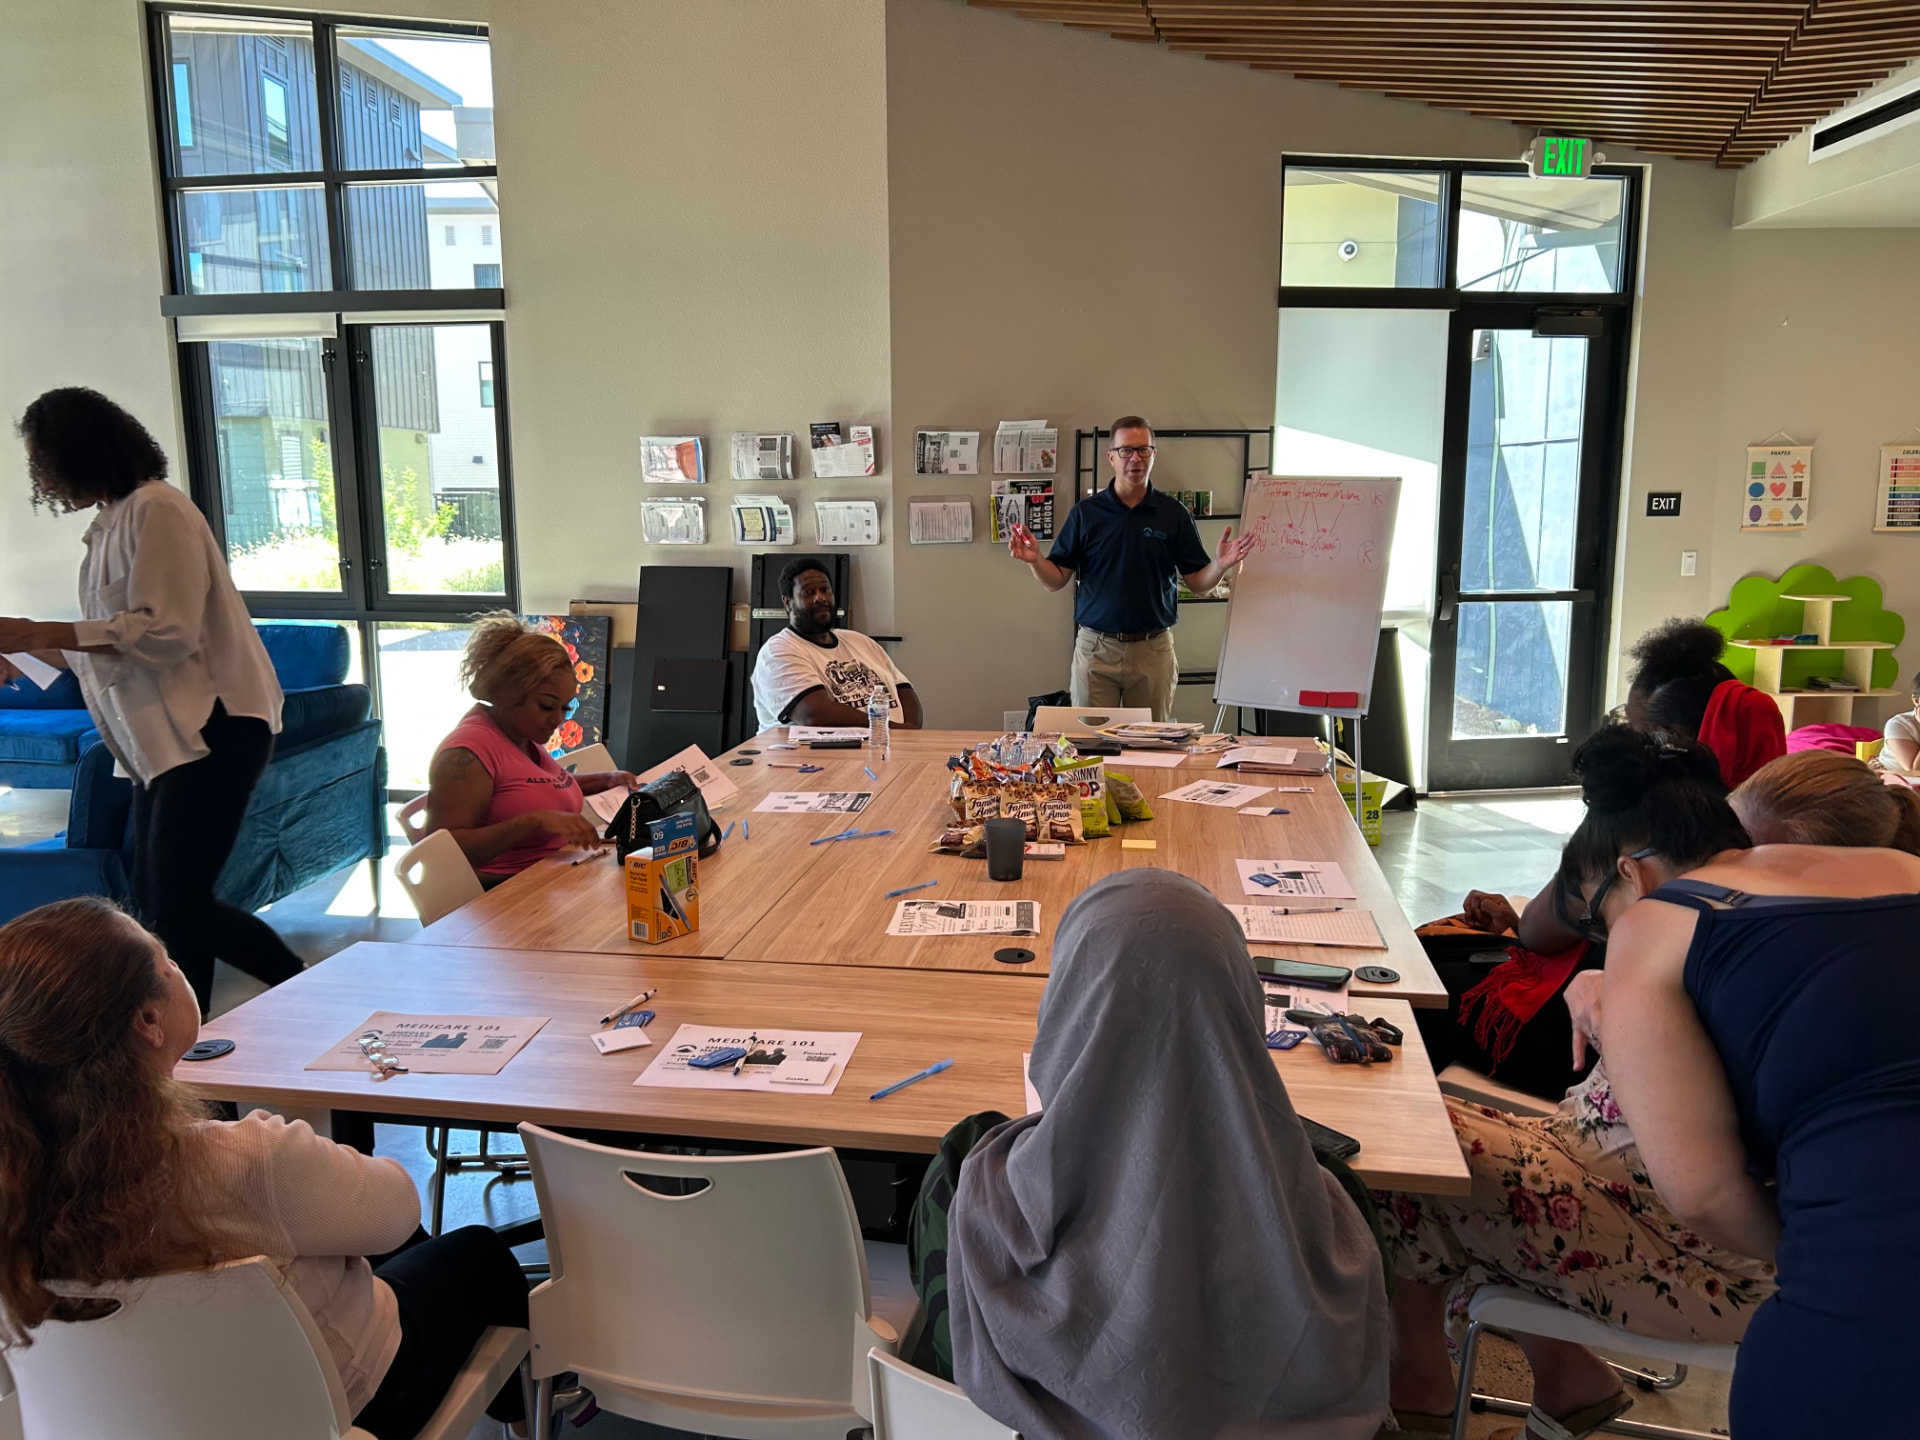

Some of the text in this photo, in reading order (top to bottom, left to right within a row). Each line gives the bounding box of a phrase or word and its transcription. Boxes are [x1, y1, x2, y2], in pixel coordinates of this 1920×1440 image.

[1543, 138, 1586, 175] EXIT
[1652, 497, 1677, 511] EXIT
[1033, 506, 1041, 529] BACK
[1044, 500, 1052, 534] SCHOOL
[1066, 767, 1099, 782] SKINNY
[1077, 781, 1100, 798] OP
[1040, 801, 1072, 815] Famous
[1366, 810, 1379, 820] 28
[1044, 810, 1070, 822] Amos
[671, 839, 689, 850] BIC
[396, 1023, 472, 1031] MEDICARE
[708, 1037, 785, 1046] MEDIARE
